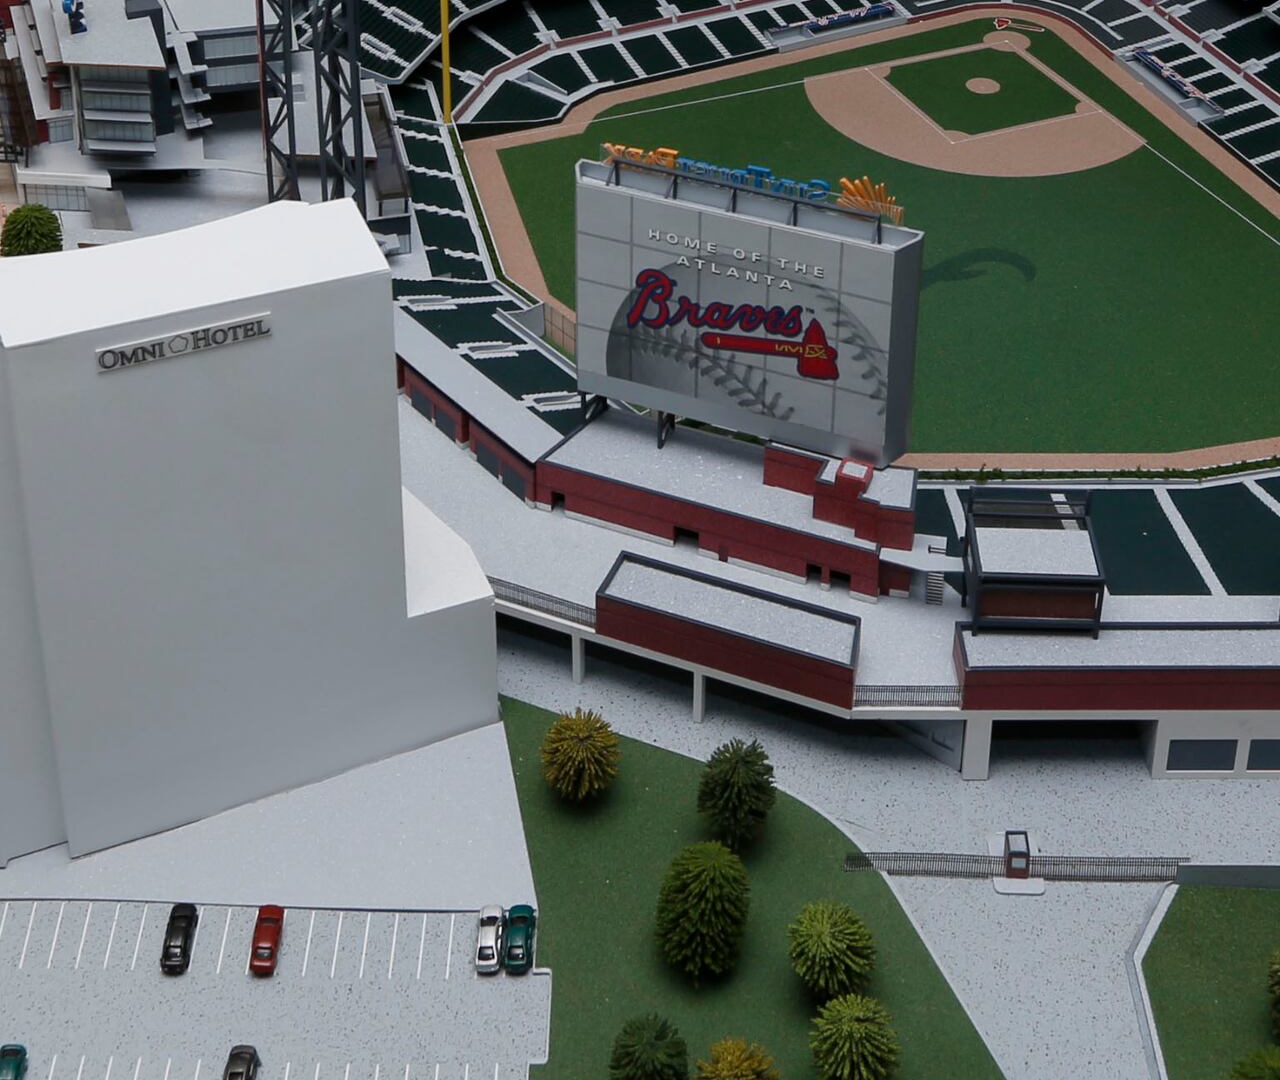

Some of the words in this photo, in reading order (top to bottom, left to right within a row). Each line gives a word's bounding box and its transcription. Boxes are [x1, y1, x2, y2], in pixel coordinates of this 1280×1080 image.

[648, 228, 718, 255] HOME
[732, 247, 762, 263] OF
[777, 256, 825, 279] THE
[676, 254, 794, 292] ATLANTA
[627, 268, 804, 338] Braves
[98, 341, 166, 370] OMNI
[191, 319, 271, 351] HOTEL
